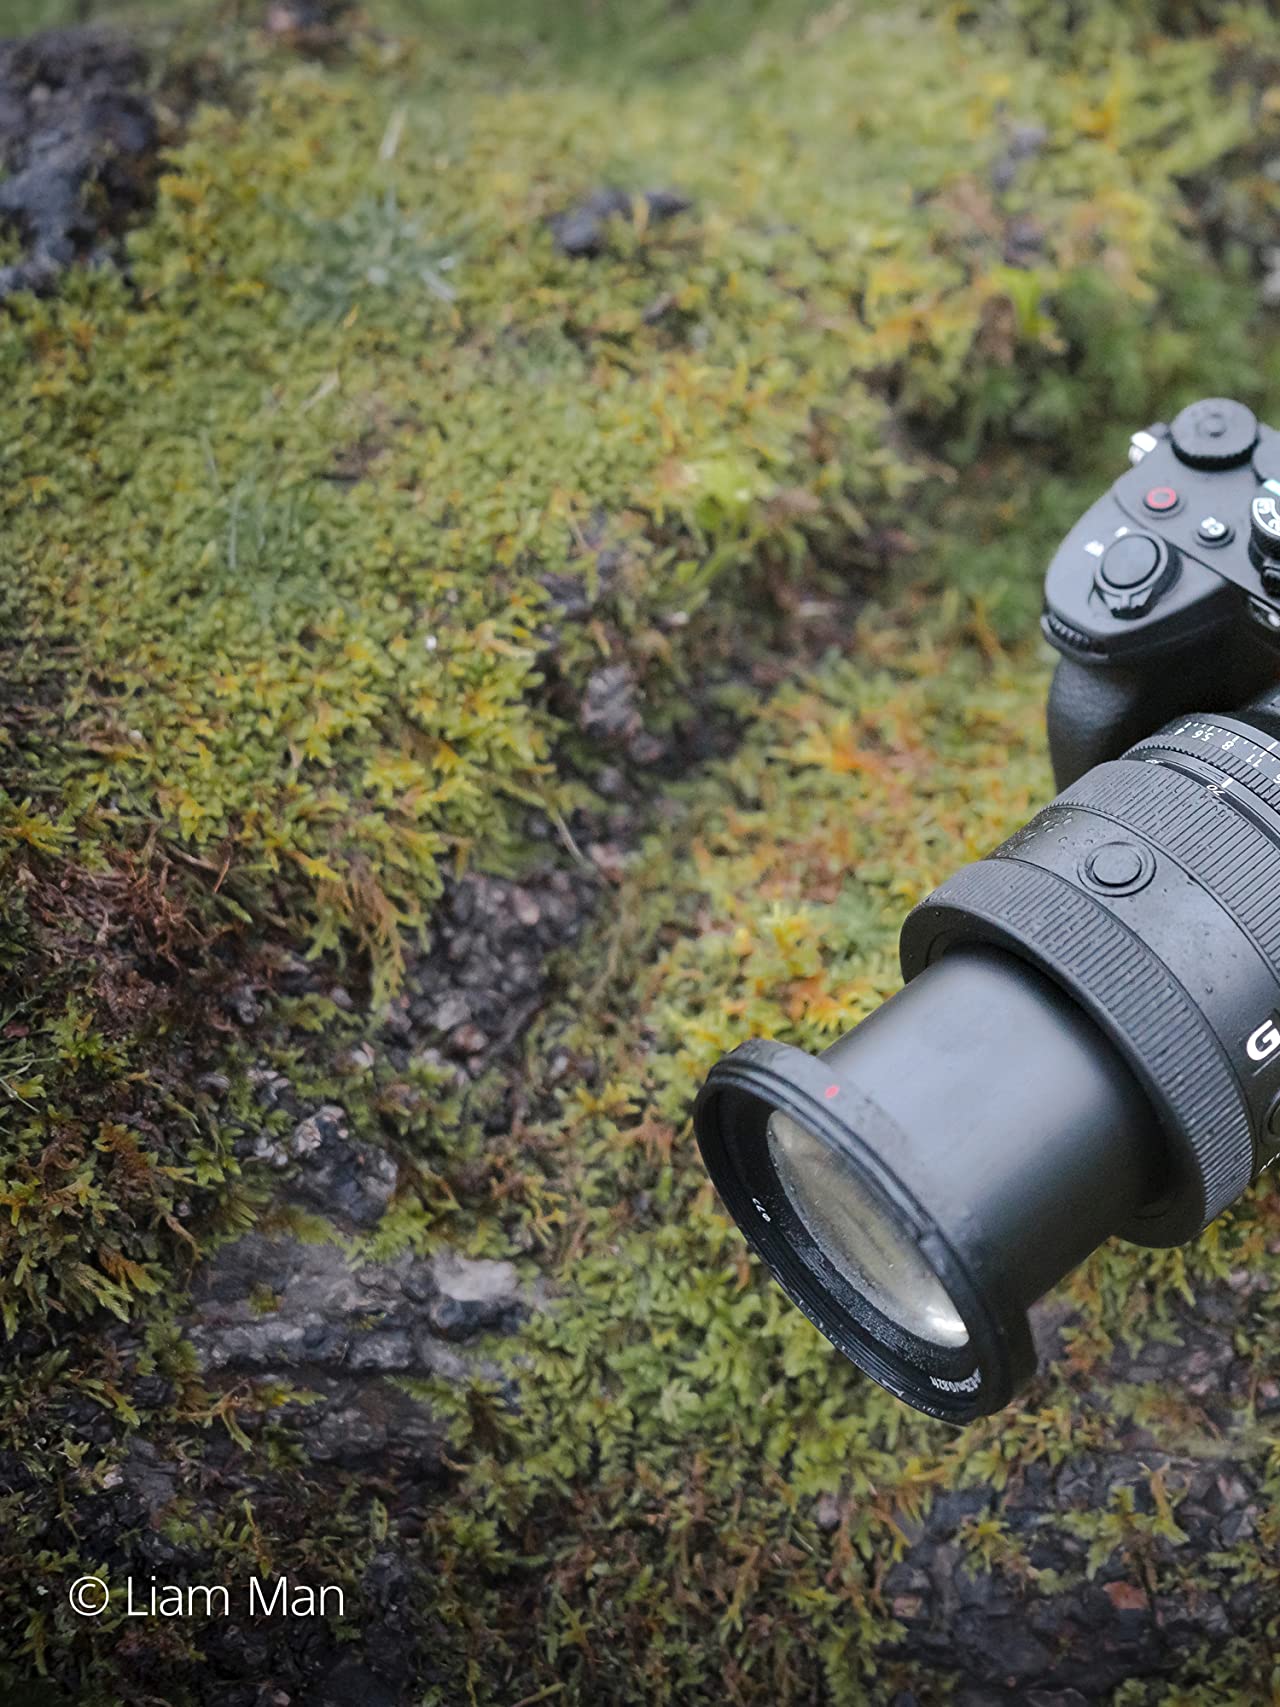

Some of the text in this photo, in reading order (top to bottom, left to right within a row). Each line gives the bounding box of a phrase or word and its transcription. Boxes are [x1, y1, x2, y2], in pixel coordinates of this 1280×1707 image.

[1221, 740, 1236, 751] 8
[1245, 753, 1263, 768] 11
[1206, 783, 1226, 797] 70
